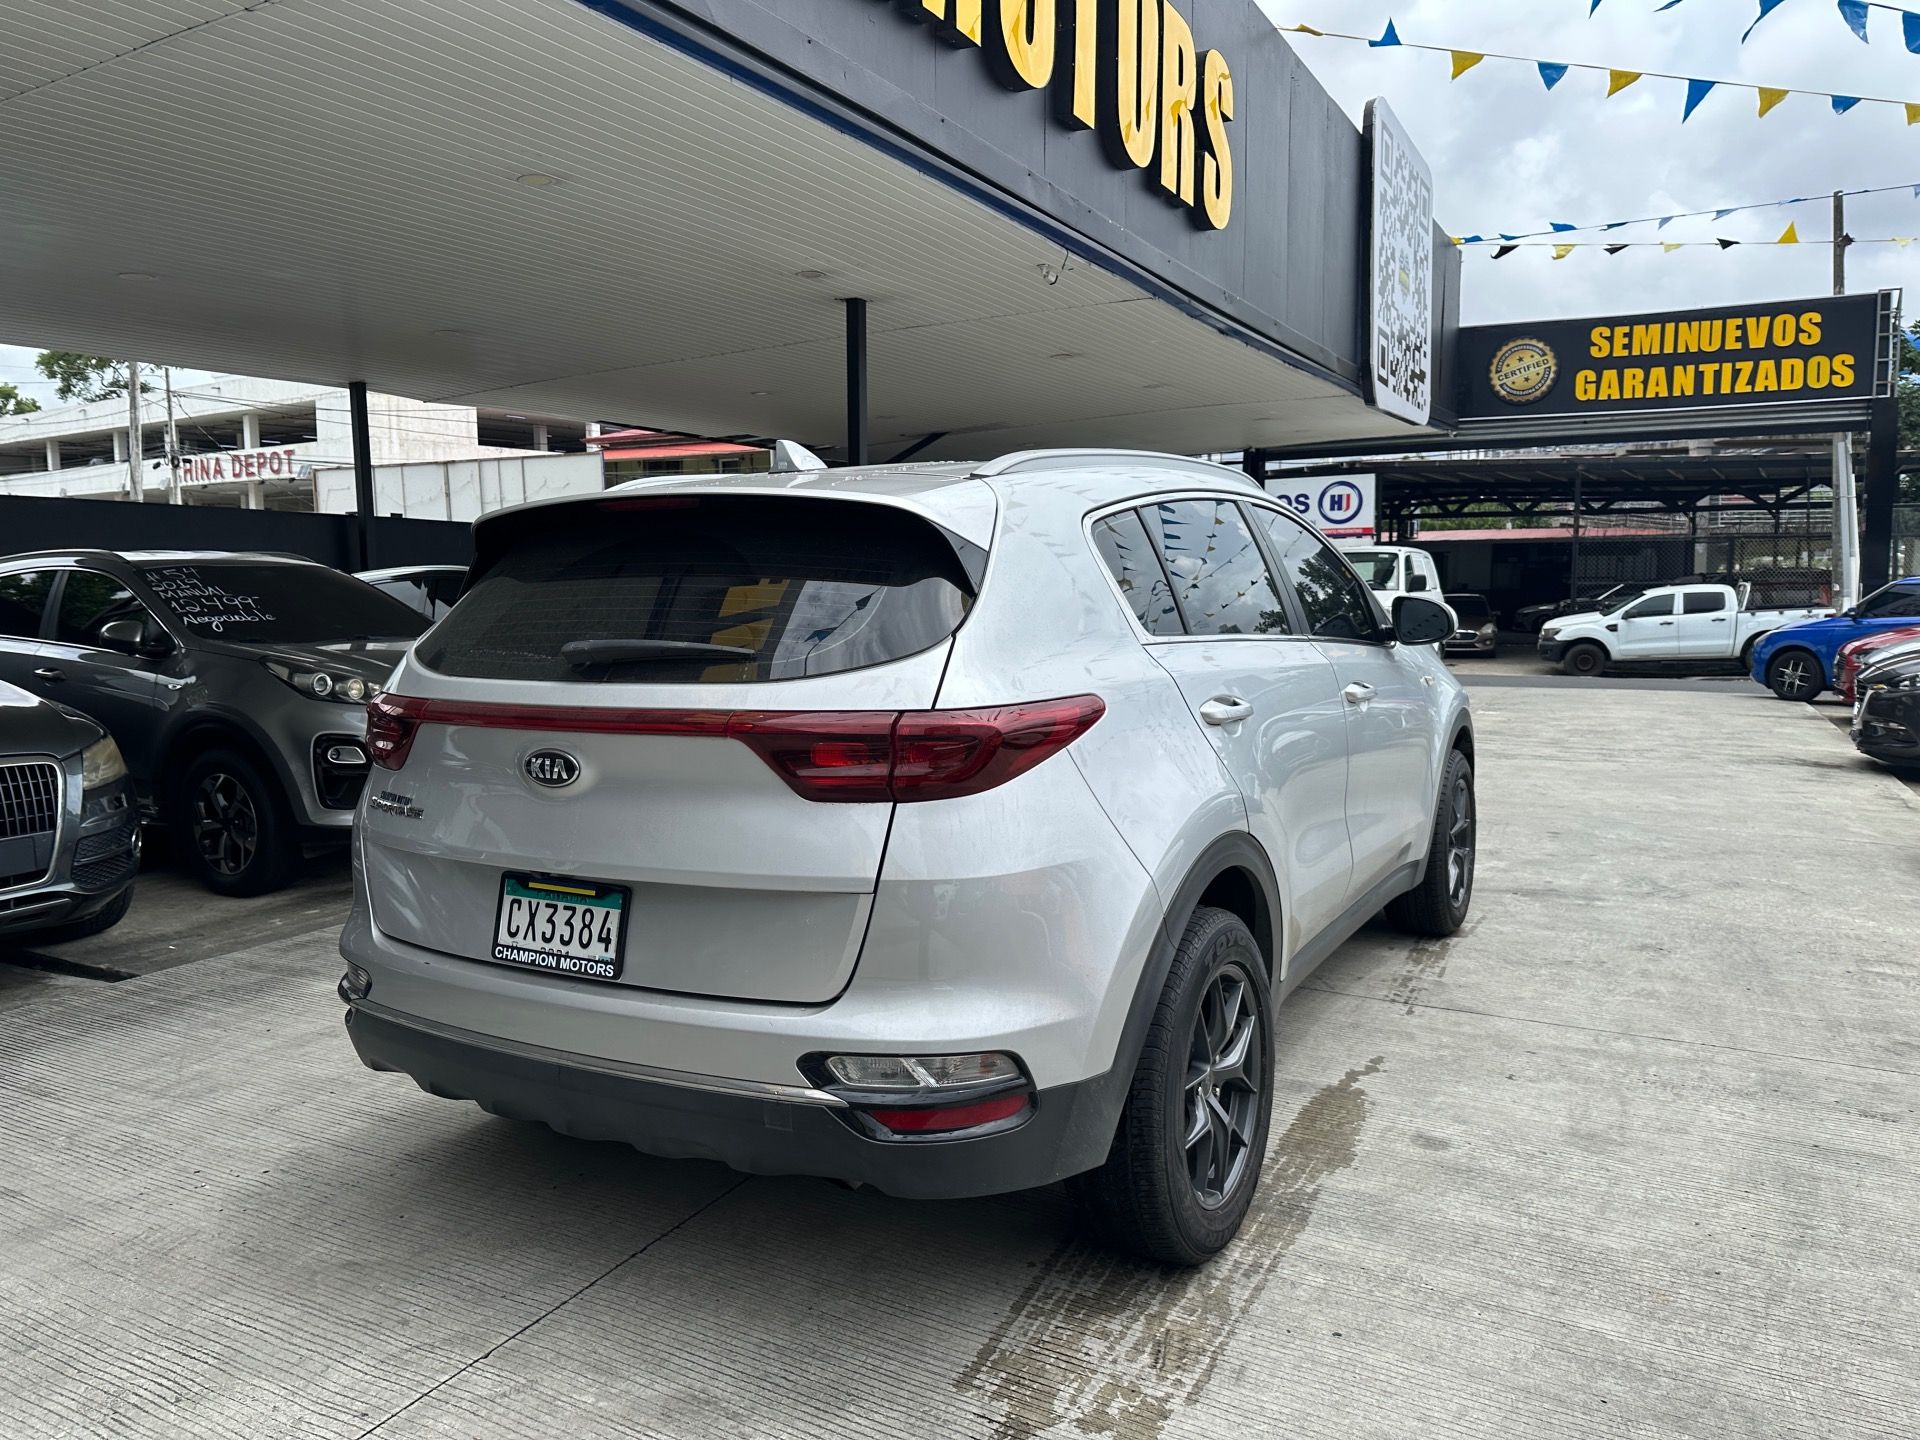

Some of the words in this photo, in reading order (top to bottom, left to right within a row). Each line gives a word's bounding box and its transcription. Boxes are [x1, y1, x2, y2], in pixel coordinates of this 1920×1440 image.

[922, 0, 1234, 230] TORS
[1589, 311, 1823, 358] SEMINUEVOS
[1497, 358, 1549, 382] CERTIFIED
[1574, 353, 1855, 401] GARANTIZADOS
[181, 457, 225, 483] HINA
[231, 449, 296, 479] DEPOT
[1329, 493, 1351, 512] HJ
[152, 578, 204, 591] 2019
[158, 586, 232, 599] MANUAL
[183, 610, 277, 632] Negociable
[530, 757, 569, 780] KIA
[506, 898, 612, 953] CX3384
[494, 946, 557, 968] CHAMPION
[559, 957, 615, 977] MOTORS
